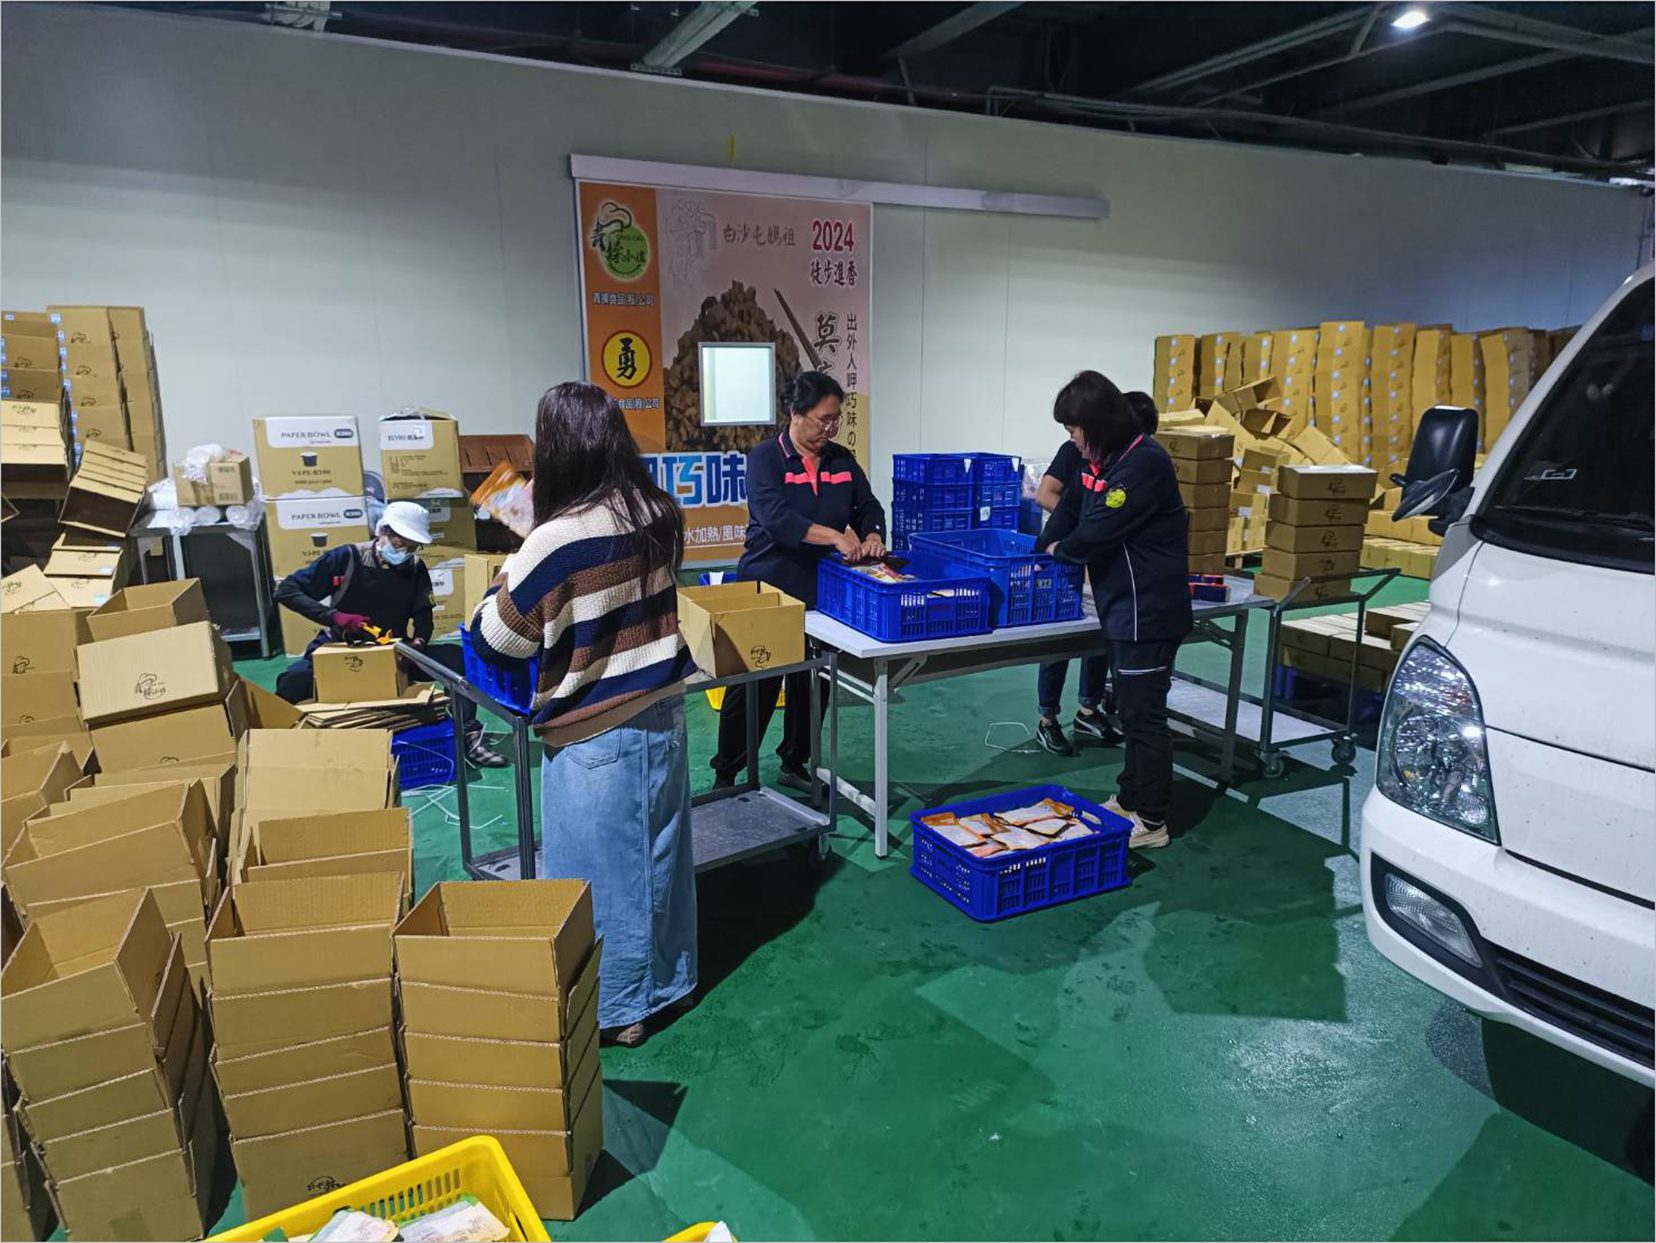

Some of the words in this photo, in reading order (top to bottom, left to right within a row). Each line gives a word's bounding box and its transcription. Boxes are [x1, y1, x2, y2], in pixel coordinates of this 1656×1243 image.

[723, 224, 796, 246] 白沙屯媽祖
[812, 220, 855, 251] 2024
[810, 260, 857, 286] 徒步進香
[616, 337, 638, 379] 勇
